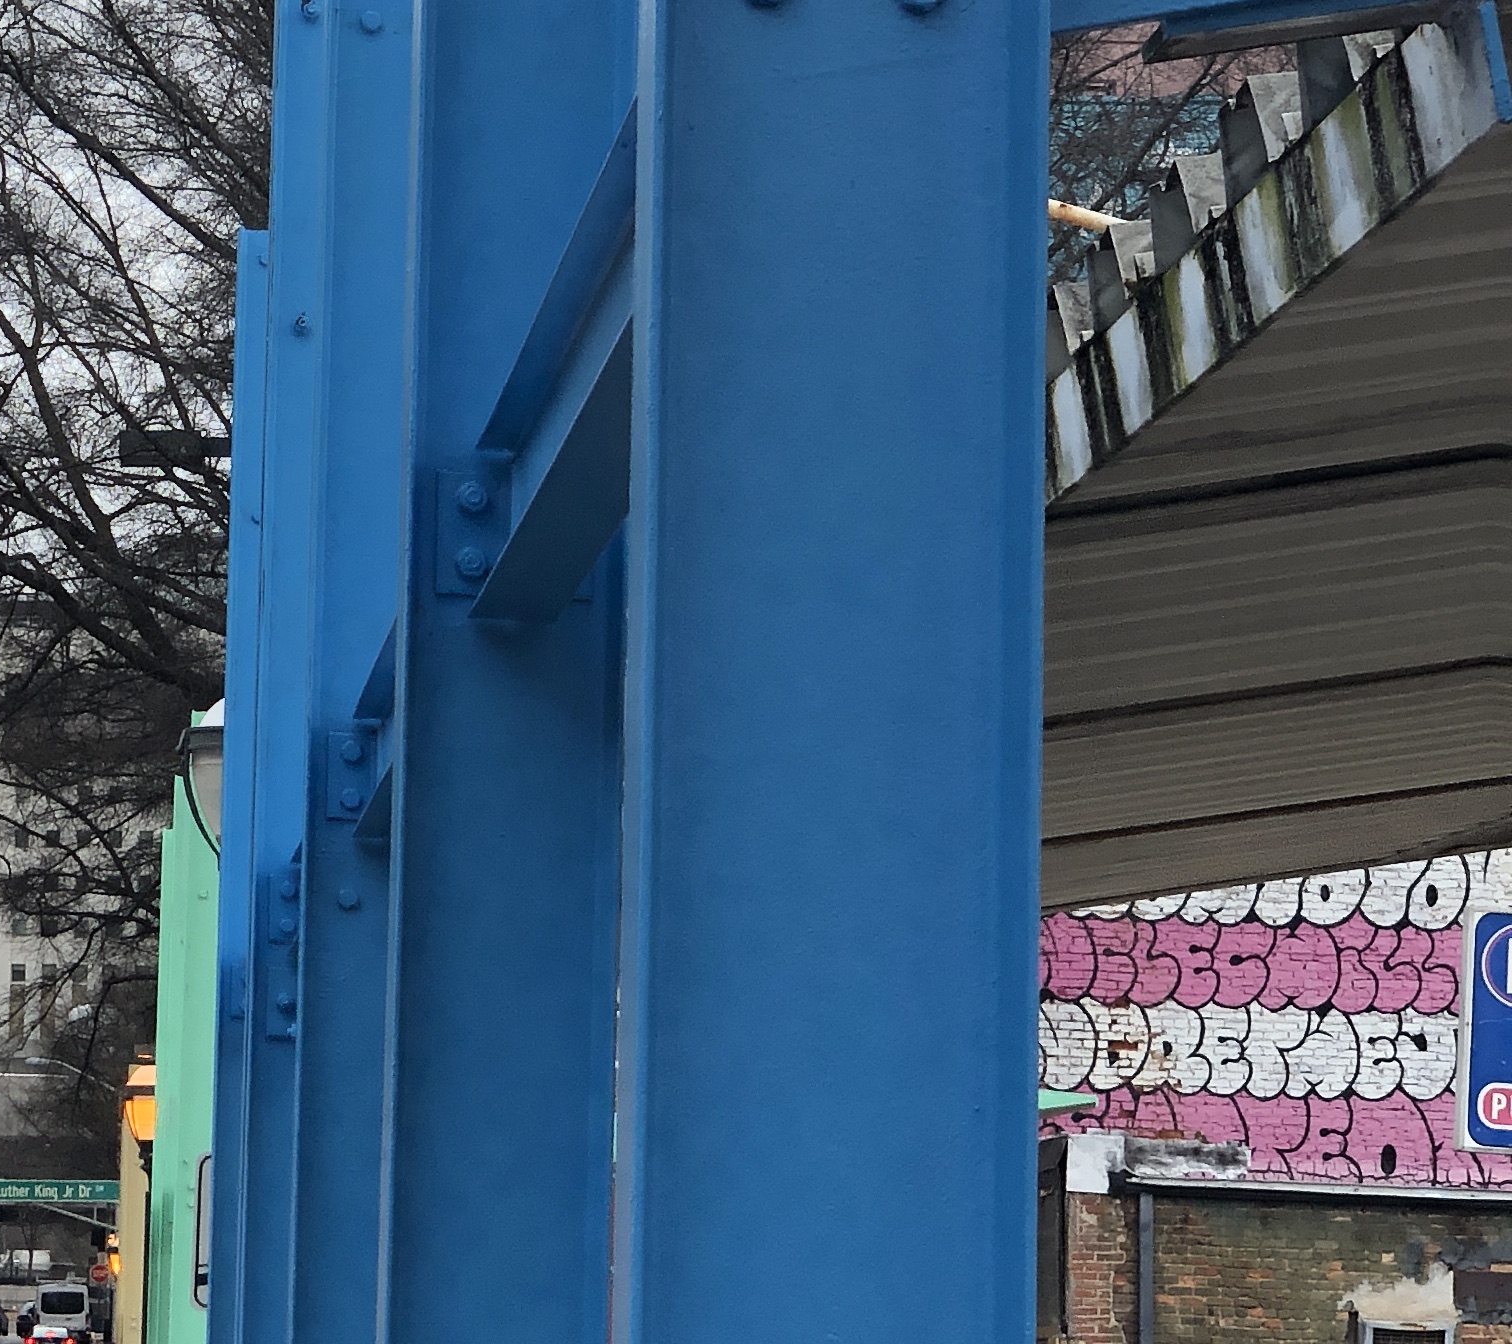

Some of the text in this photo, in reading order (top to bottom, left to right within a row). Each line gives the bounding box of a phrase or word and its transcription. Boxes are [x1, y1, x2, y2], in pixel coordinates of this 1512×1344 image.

[34, 1185, 58, 1200] King
[62, 1185, 74, 1198] Jr
[78, 1184, 92, 1197] Dr
